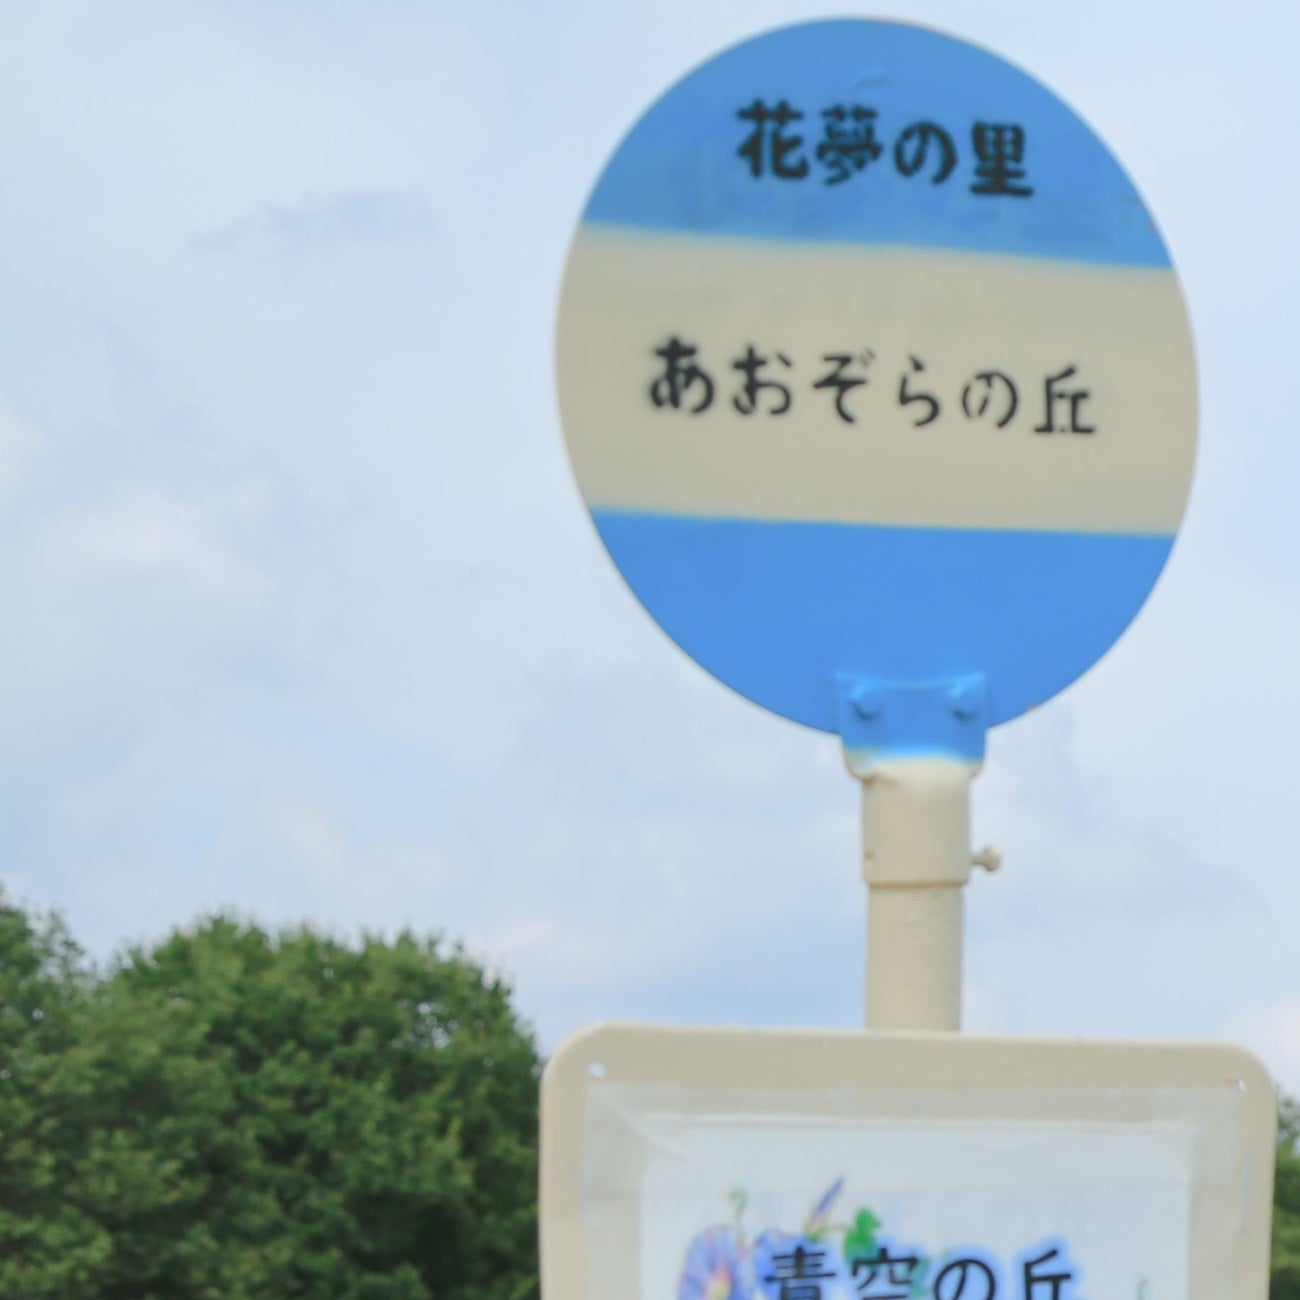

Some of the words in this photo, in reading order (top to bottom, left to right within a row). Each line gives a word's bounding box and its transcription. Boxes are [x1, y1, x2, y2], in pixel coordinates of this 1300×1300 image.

[735, 98, 1034, 197] 花夢の里
[648, 335, 1096, 436] あおぞらの丘
